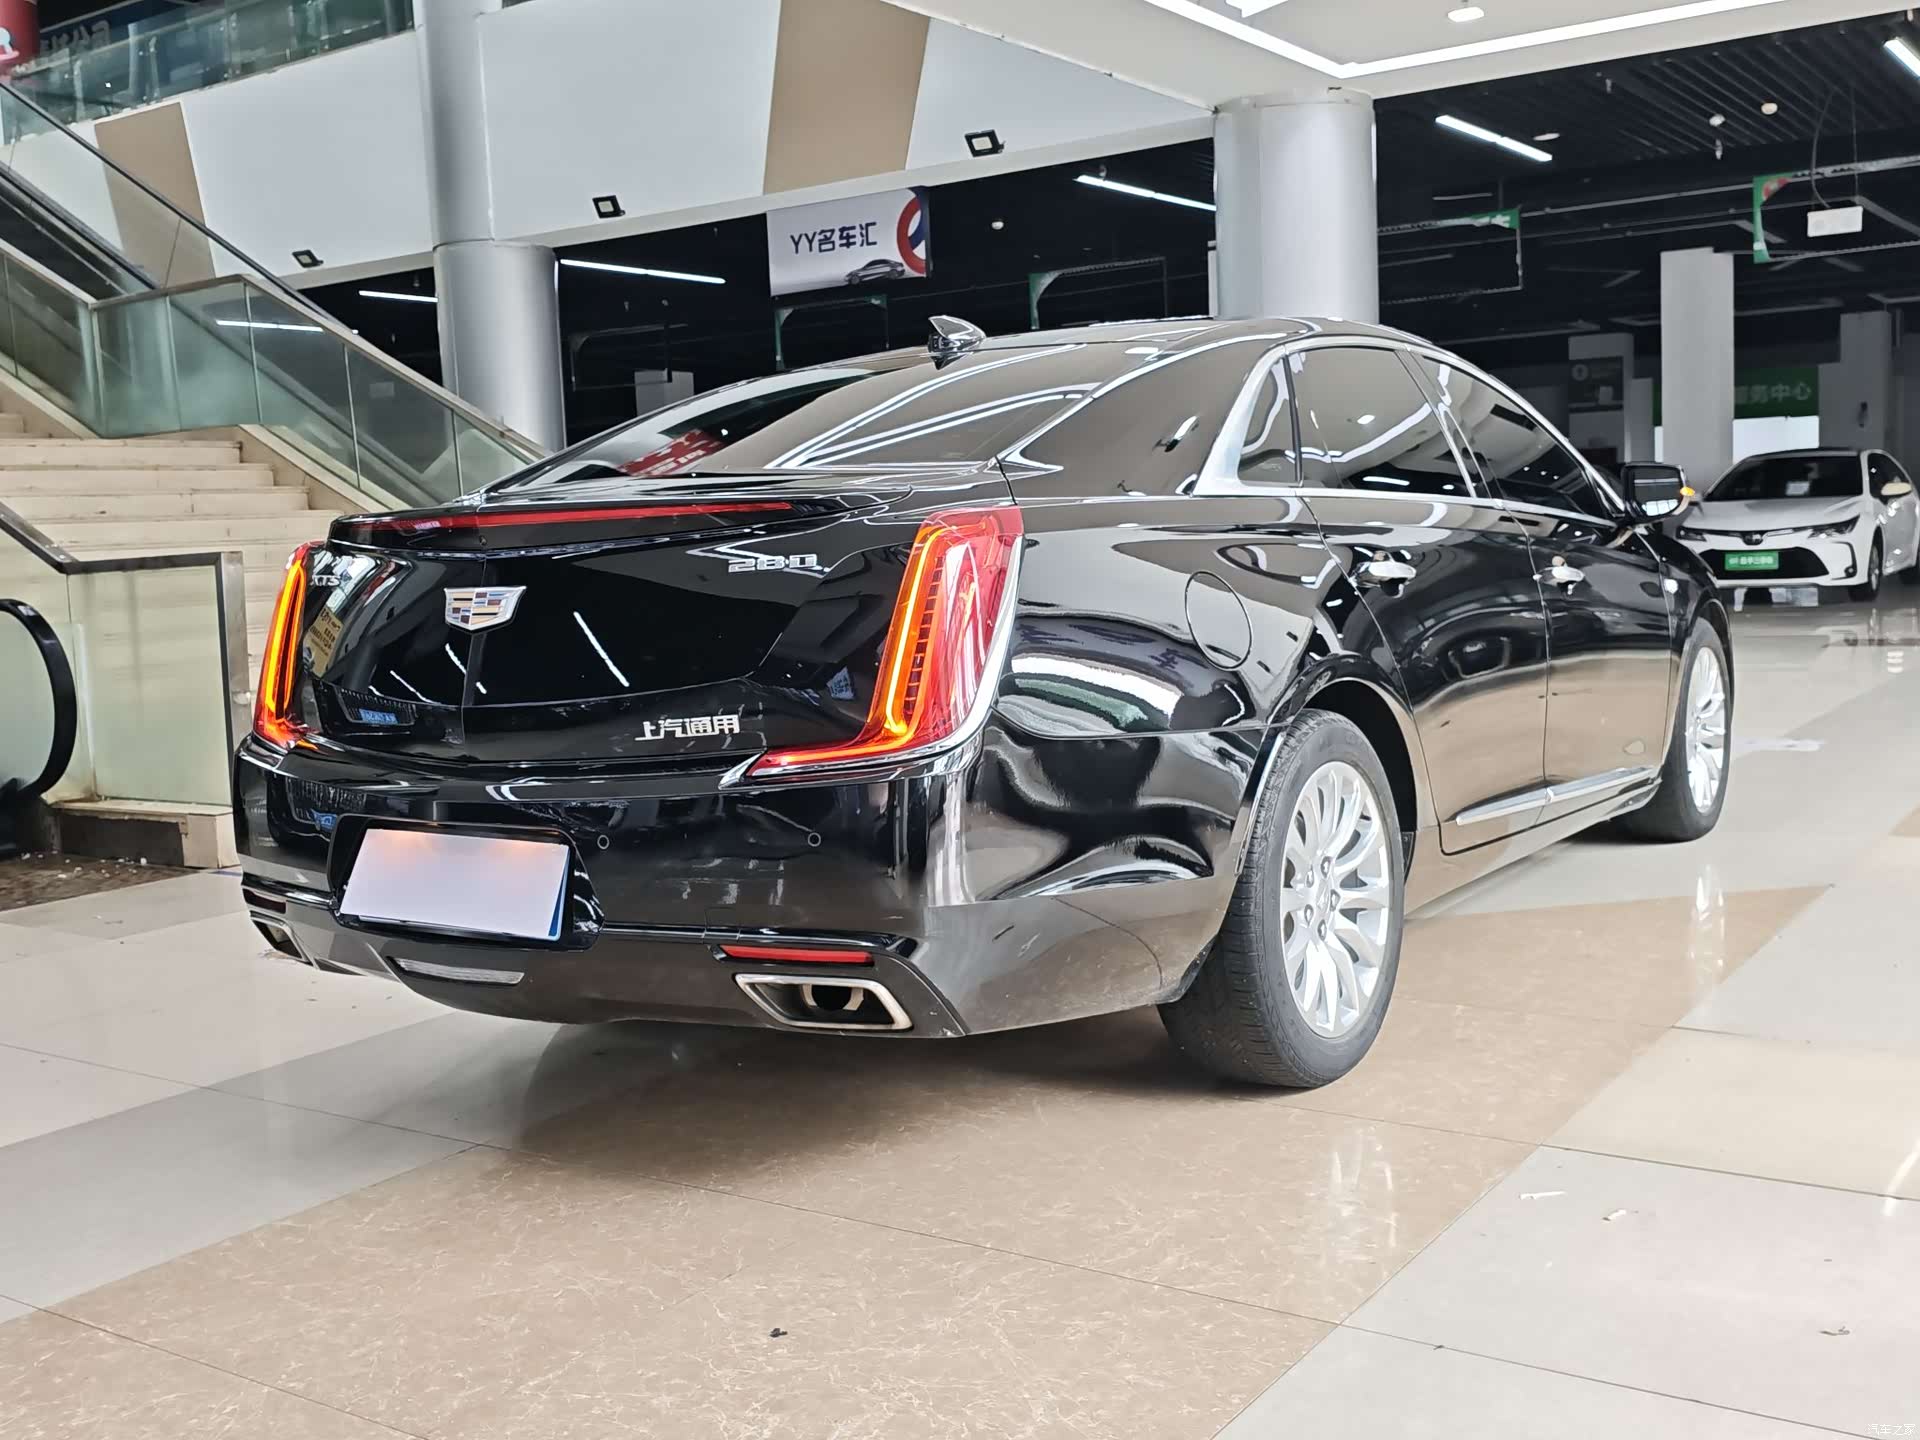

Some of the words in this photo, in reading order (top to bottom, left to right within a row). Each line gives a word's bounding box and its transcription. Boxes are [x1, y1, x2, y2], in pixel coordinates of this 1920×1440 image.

[790, 221, 878, 254] YY名车汇
[728, 553, 817, 573] 280
[635, 714, 740, 741] 上汽通用
